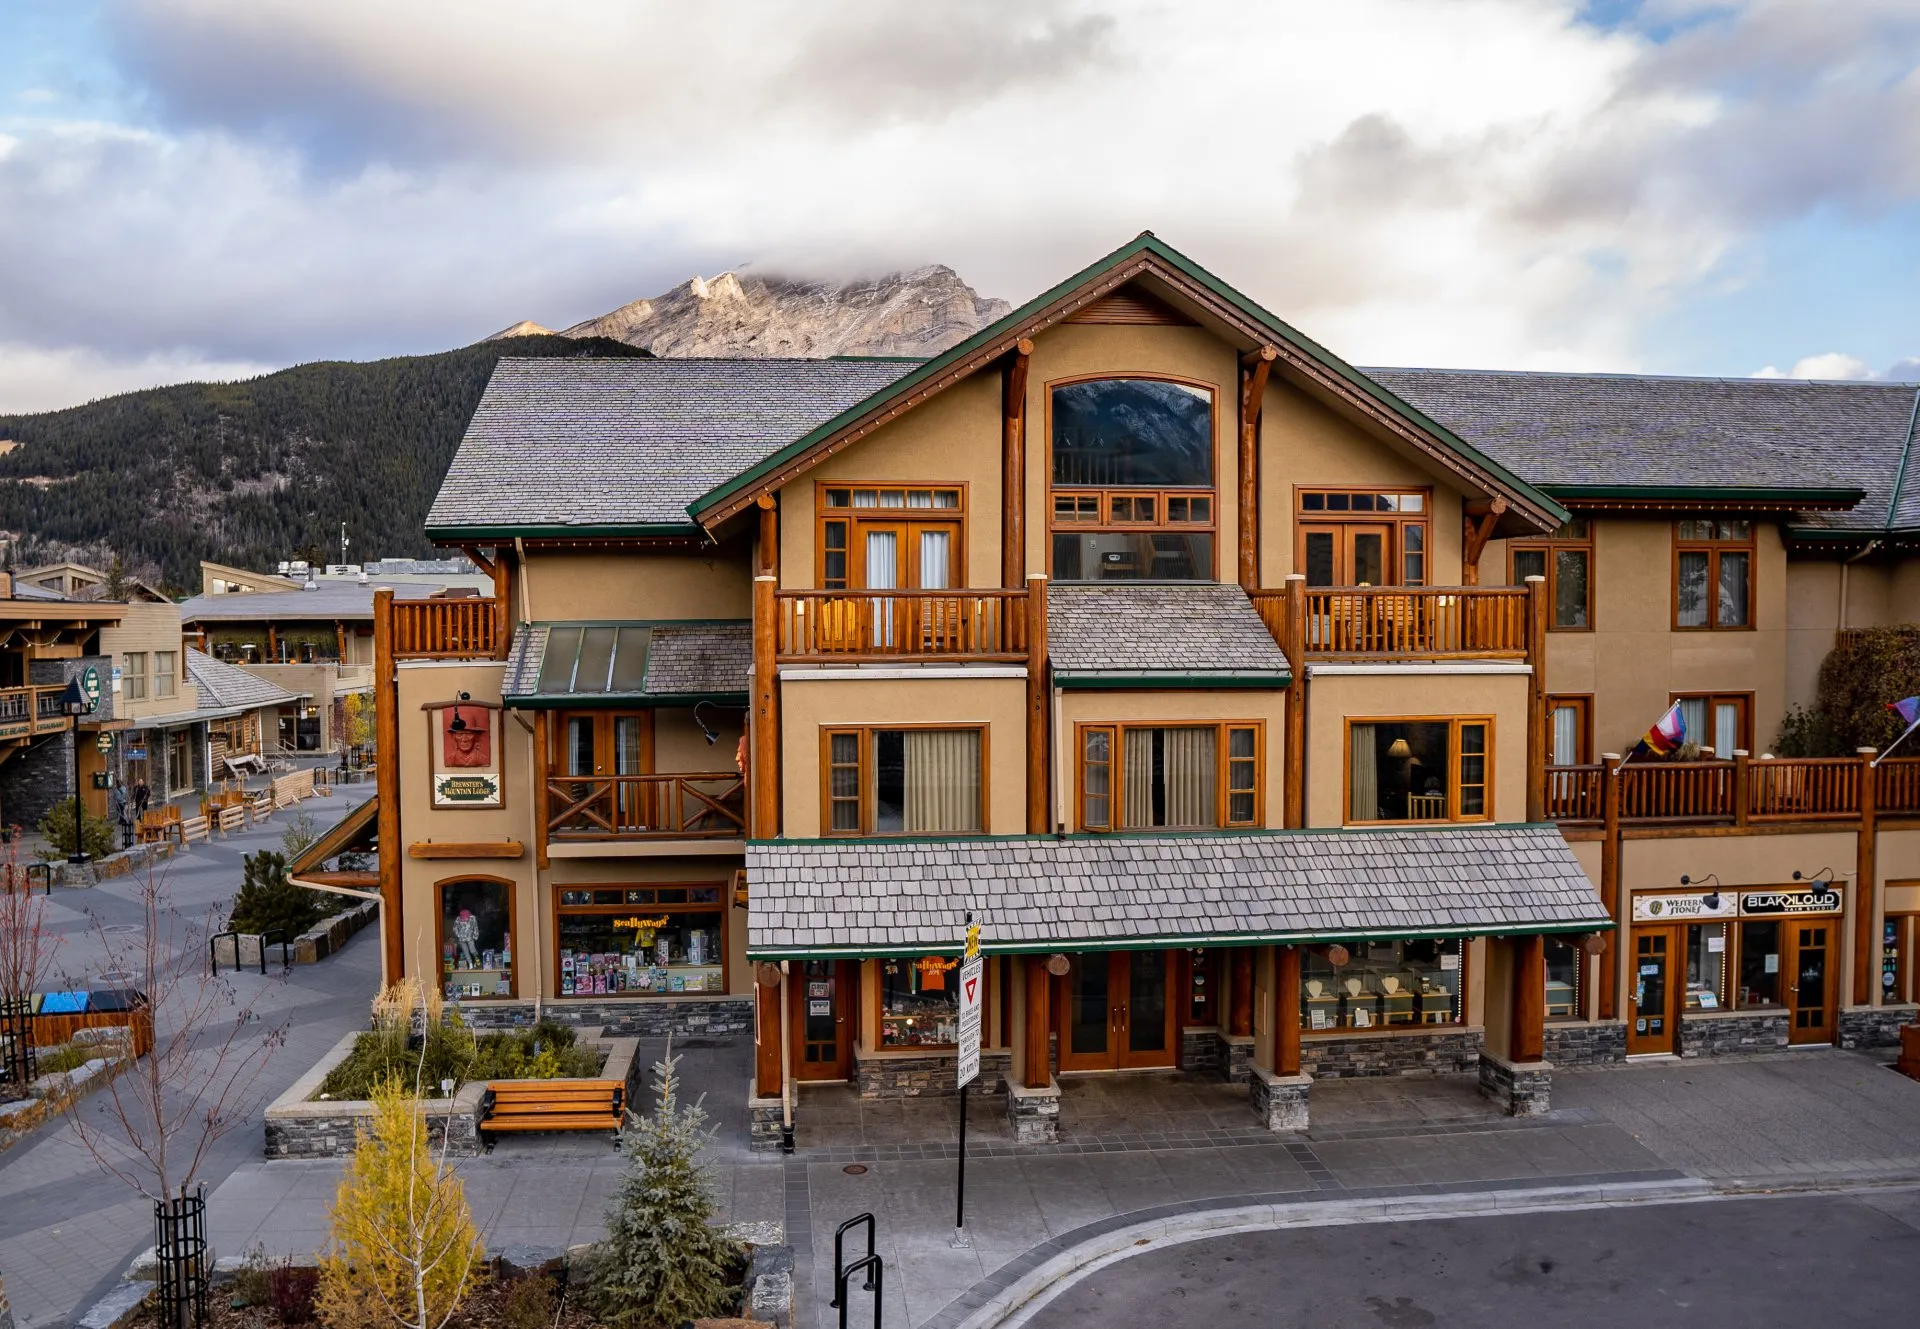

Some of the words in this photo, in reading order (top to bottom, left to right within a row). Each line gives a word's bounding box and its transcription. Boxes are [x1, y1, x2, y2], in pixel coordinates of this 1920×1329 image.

[444, 787, 472, 795] MOUNTAIN
[473, 787, 490, 795] LODGE
[1666, 899, 1705, 907] WESTERN
[1669, 906, 1702, 915] STONES
[961, 963, 981, 981] VEHICLES
[959, 1066, 966, 1079] 20
